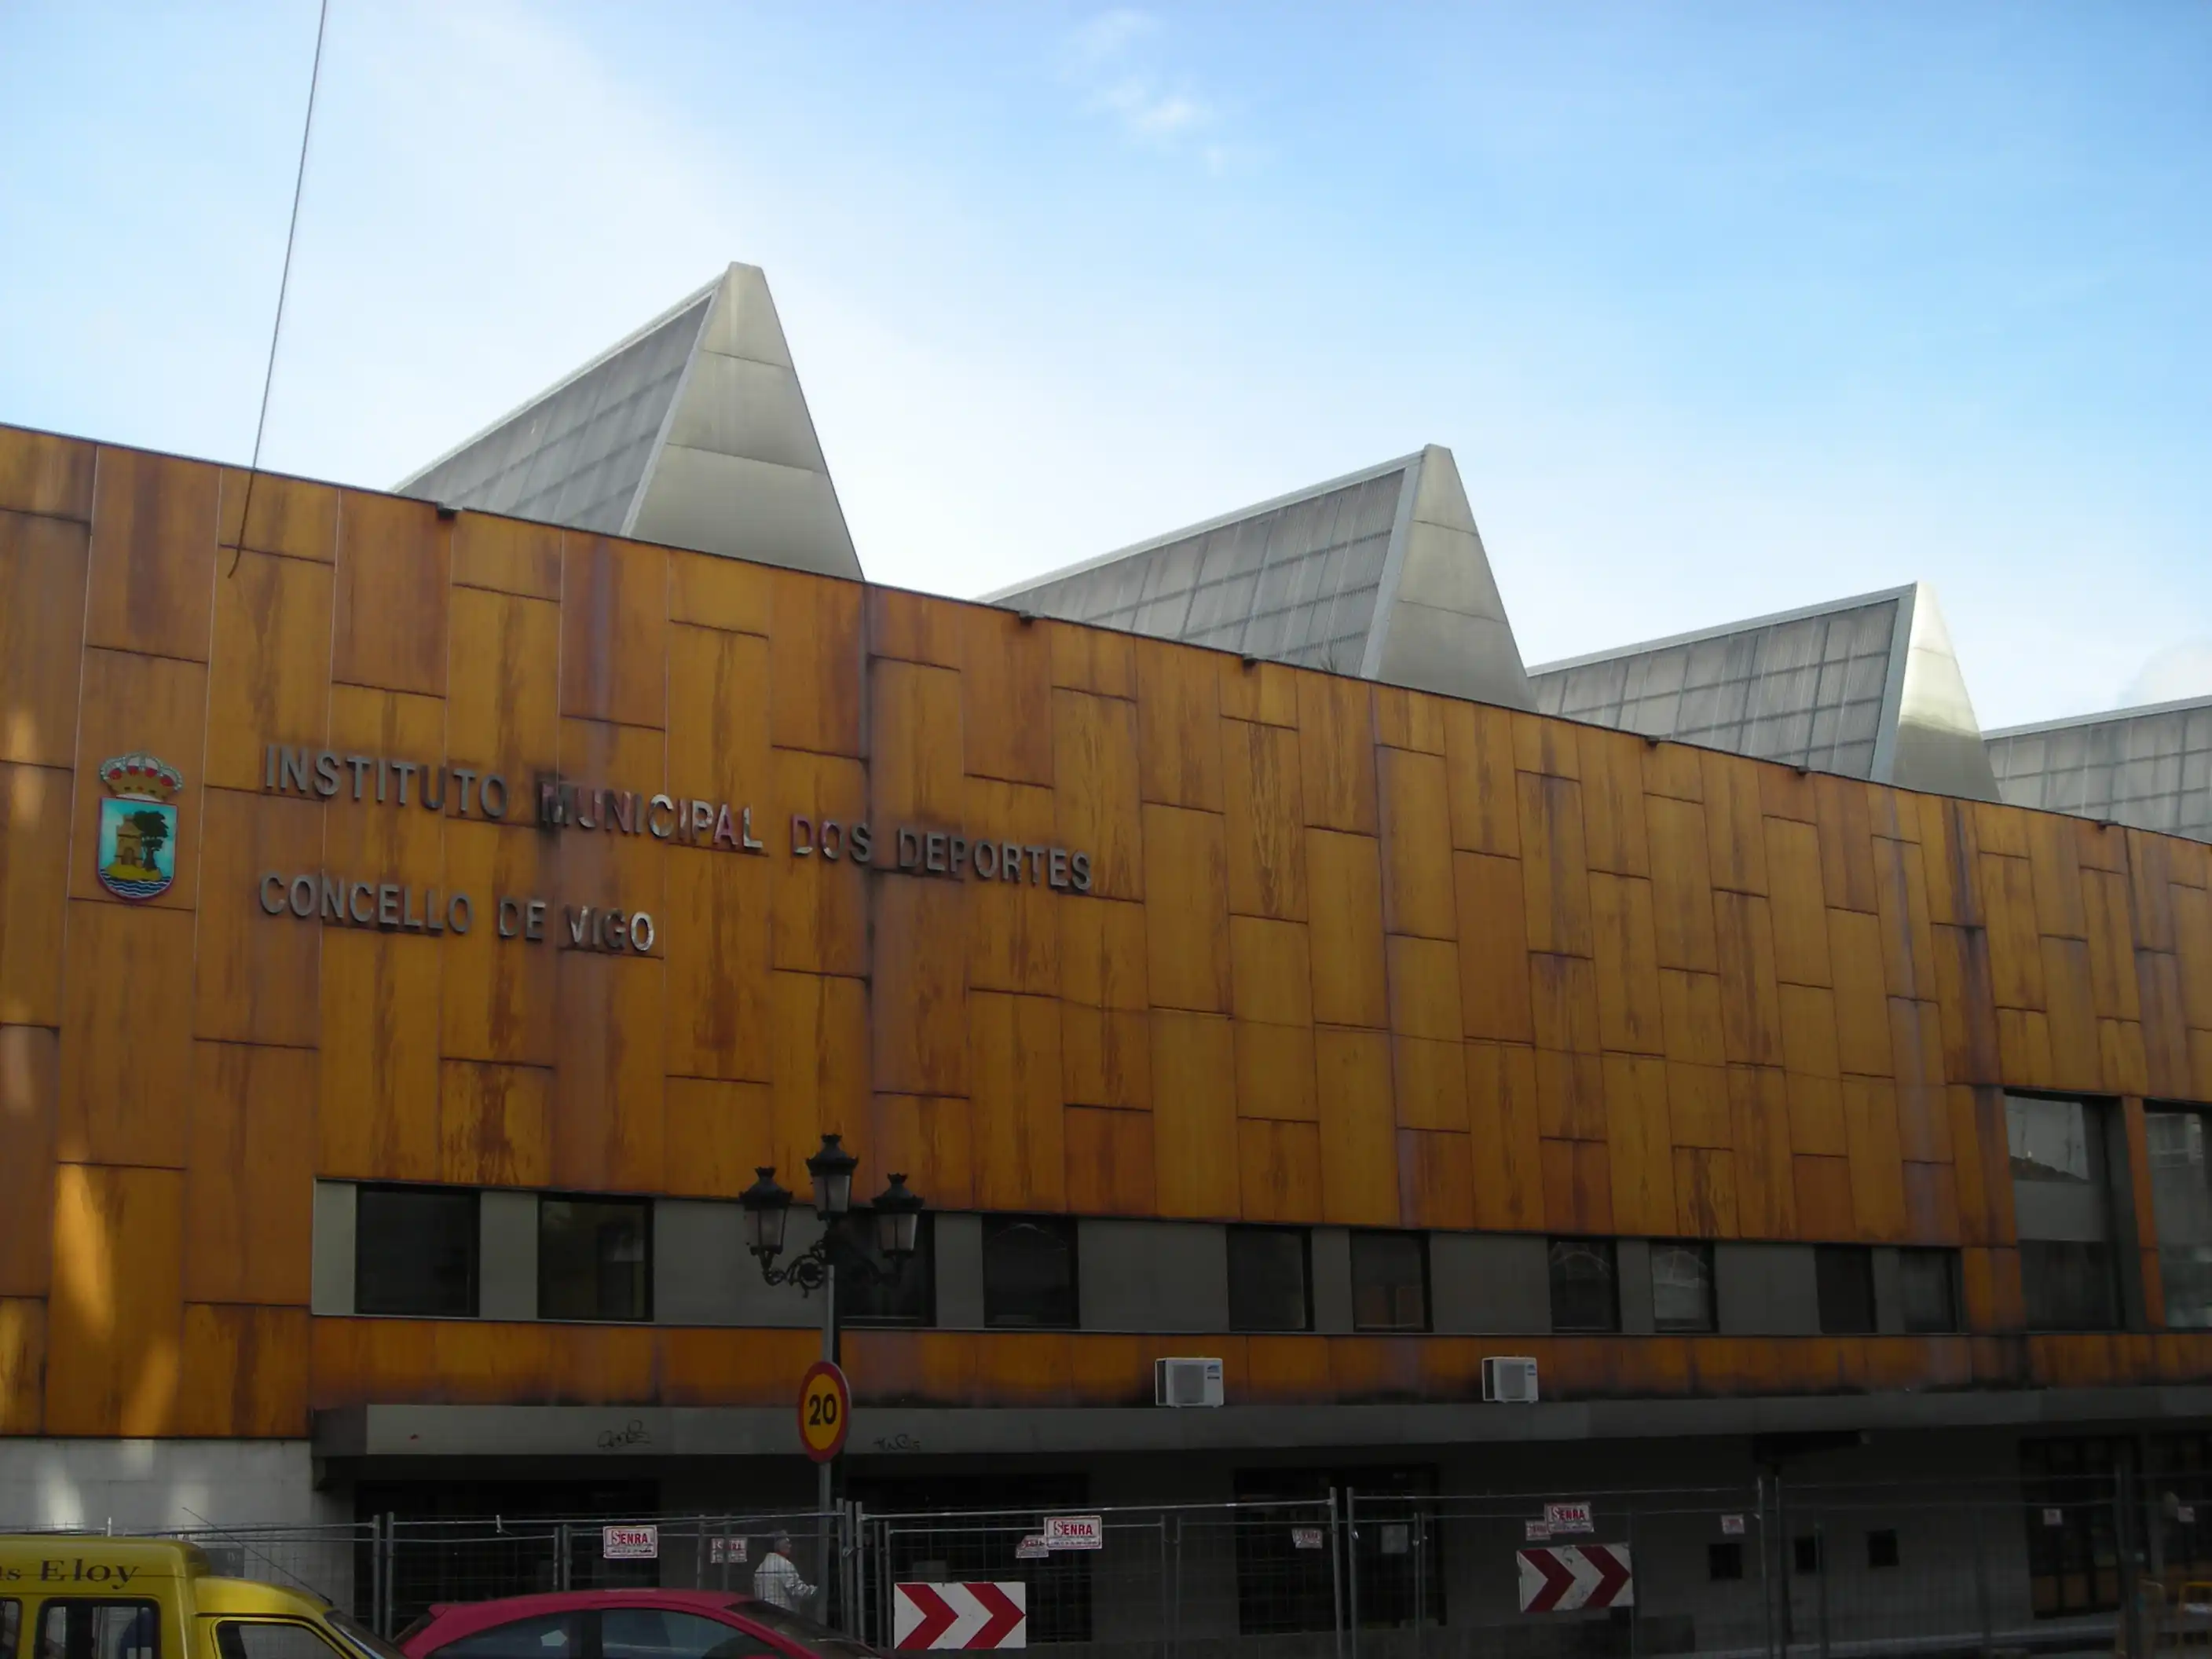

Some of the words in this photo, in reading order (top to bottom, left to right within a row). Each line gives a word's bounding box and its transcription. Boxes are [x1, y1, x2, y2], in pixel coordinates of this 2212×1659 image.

[265, 743, 509, 819] INSTITUTO
[540, 780, 764, 850] MUNICIPAL
[791, 813, 872, 862] DOS
[898, 826, 1092, 891] DEPORTES
[260, 870, 473, 934] CONCELLO
[499, 896, 546, 941] DE
[566, 905, 655, 953] VIGO
[808, 1393, 838, 1426] 20
[612, 1530, 648, 1545] SENRA
[1053, 1521, 1093, 1536] SENRA
[40, 1558, 141, 1590] Eloy
